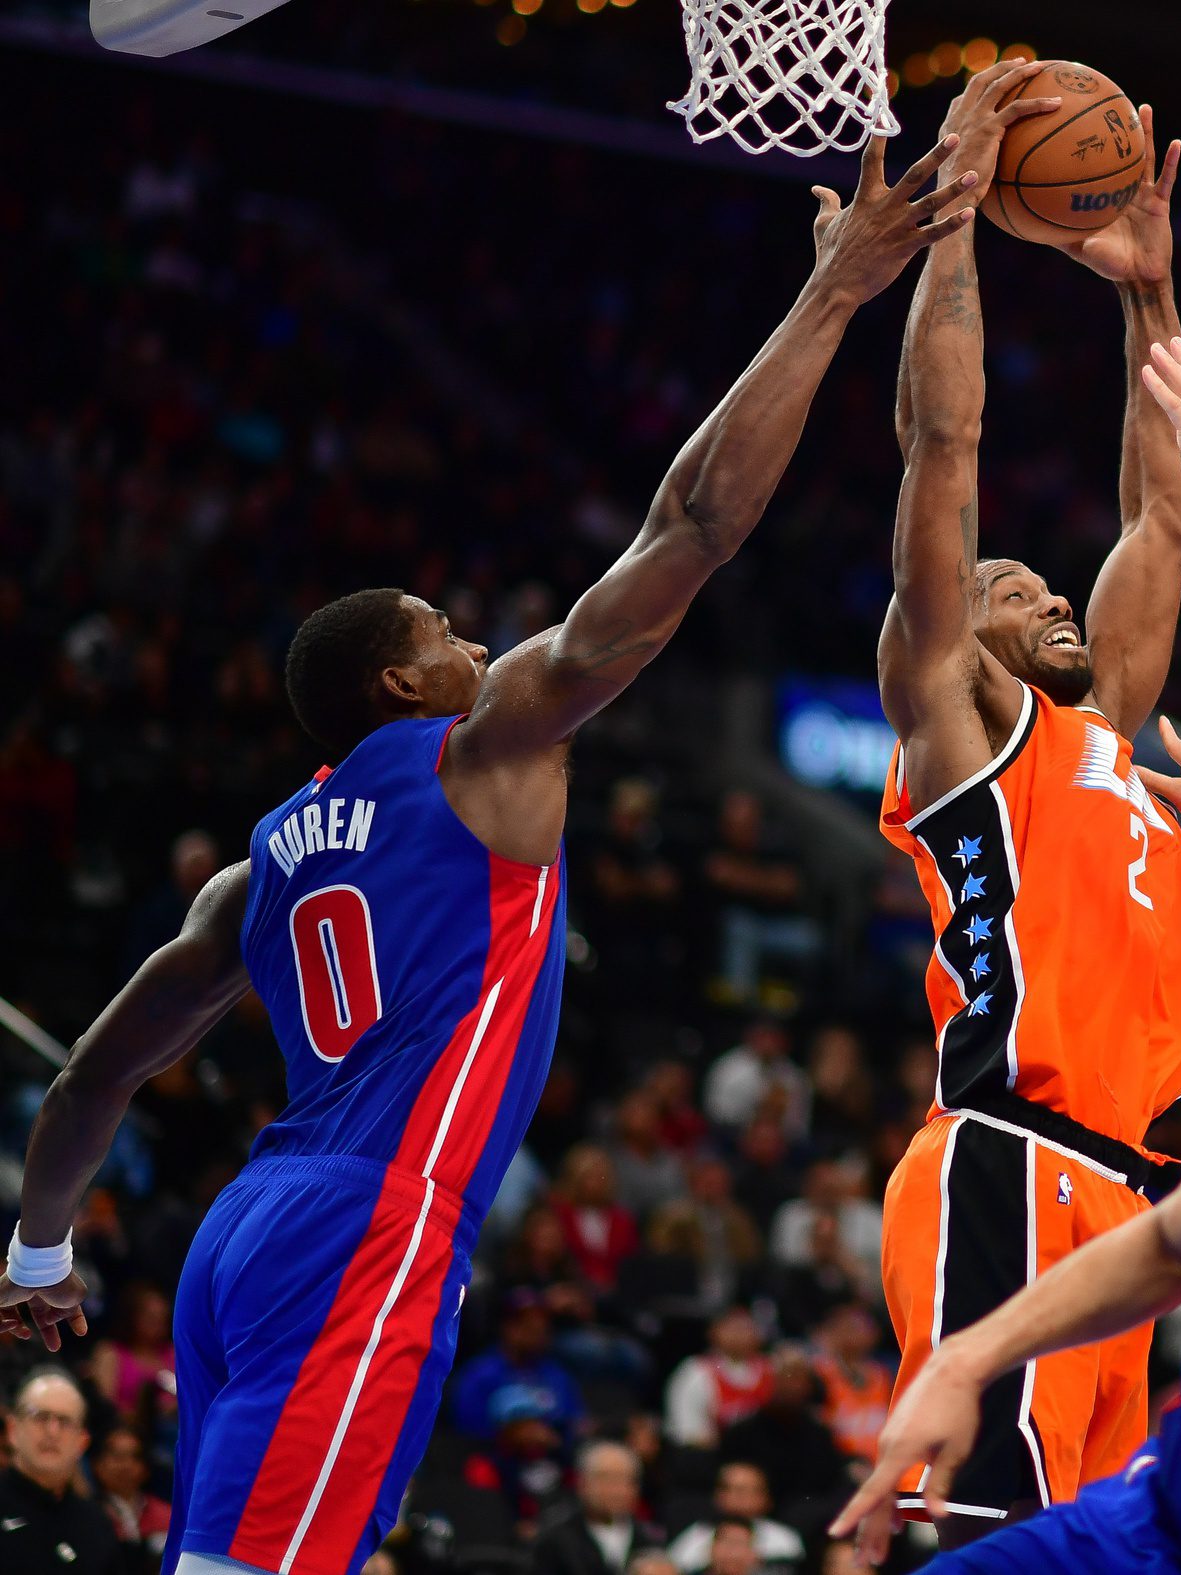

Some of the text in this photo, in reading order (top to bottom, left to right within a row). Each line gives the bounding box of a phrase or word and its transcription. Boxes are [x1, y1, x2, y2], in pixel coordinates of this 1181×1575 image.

[268, 798, 376, 879] DUREN
[1127, 812, 1154, 911] 2
[289, 884, 383, 1064] 0
